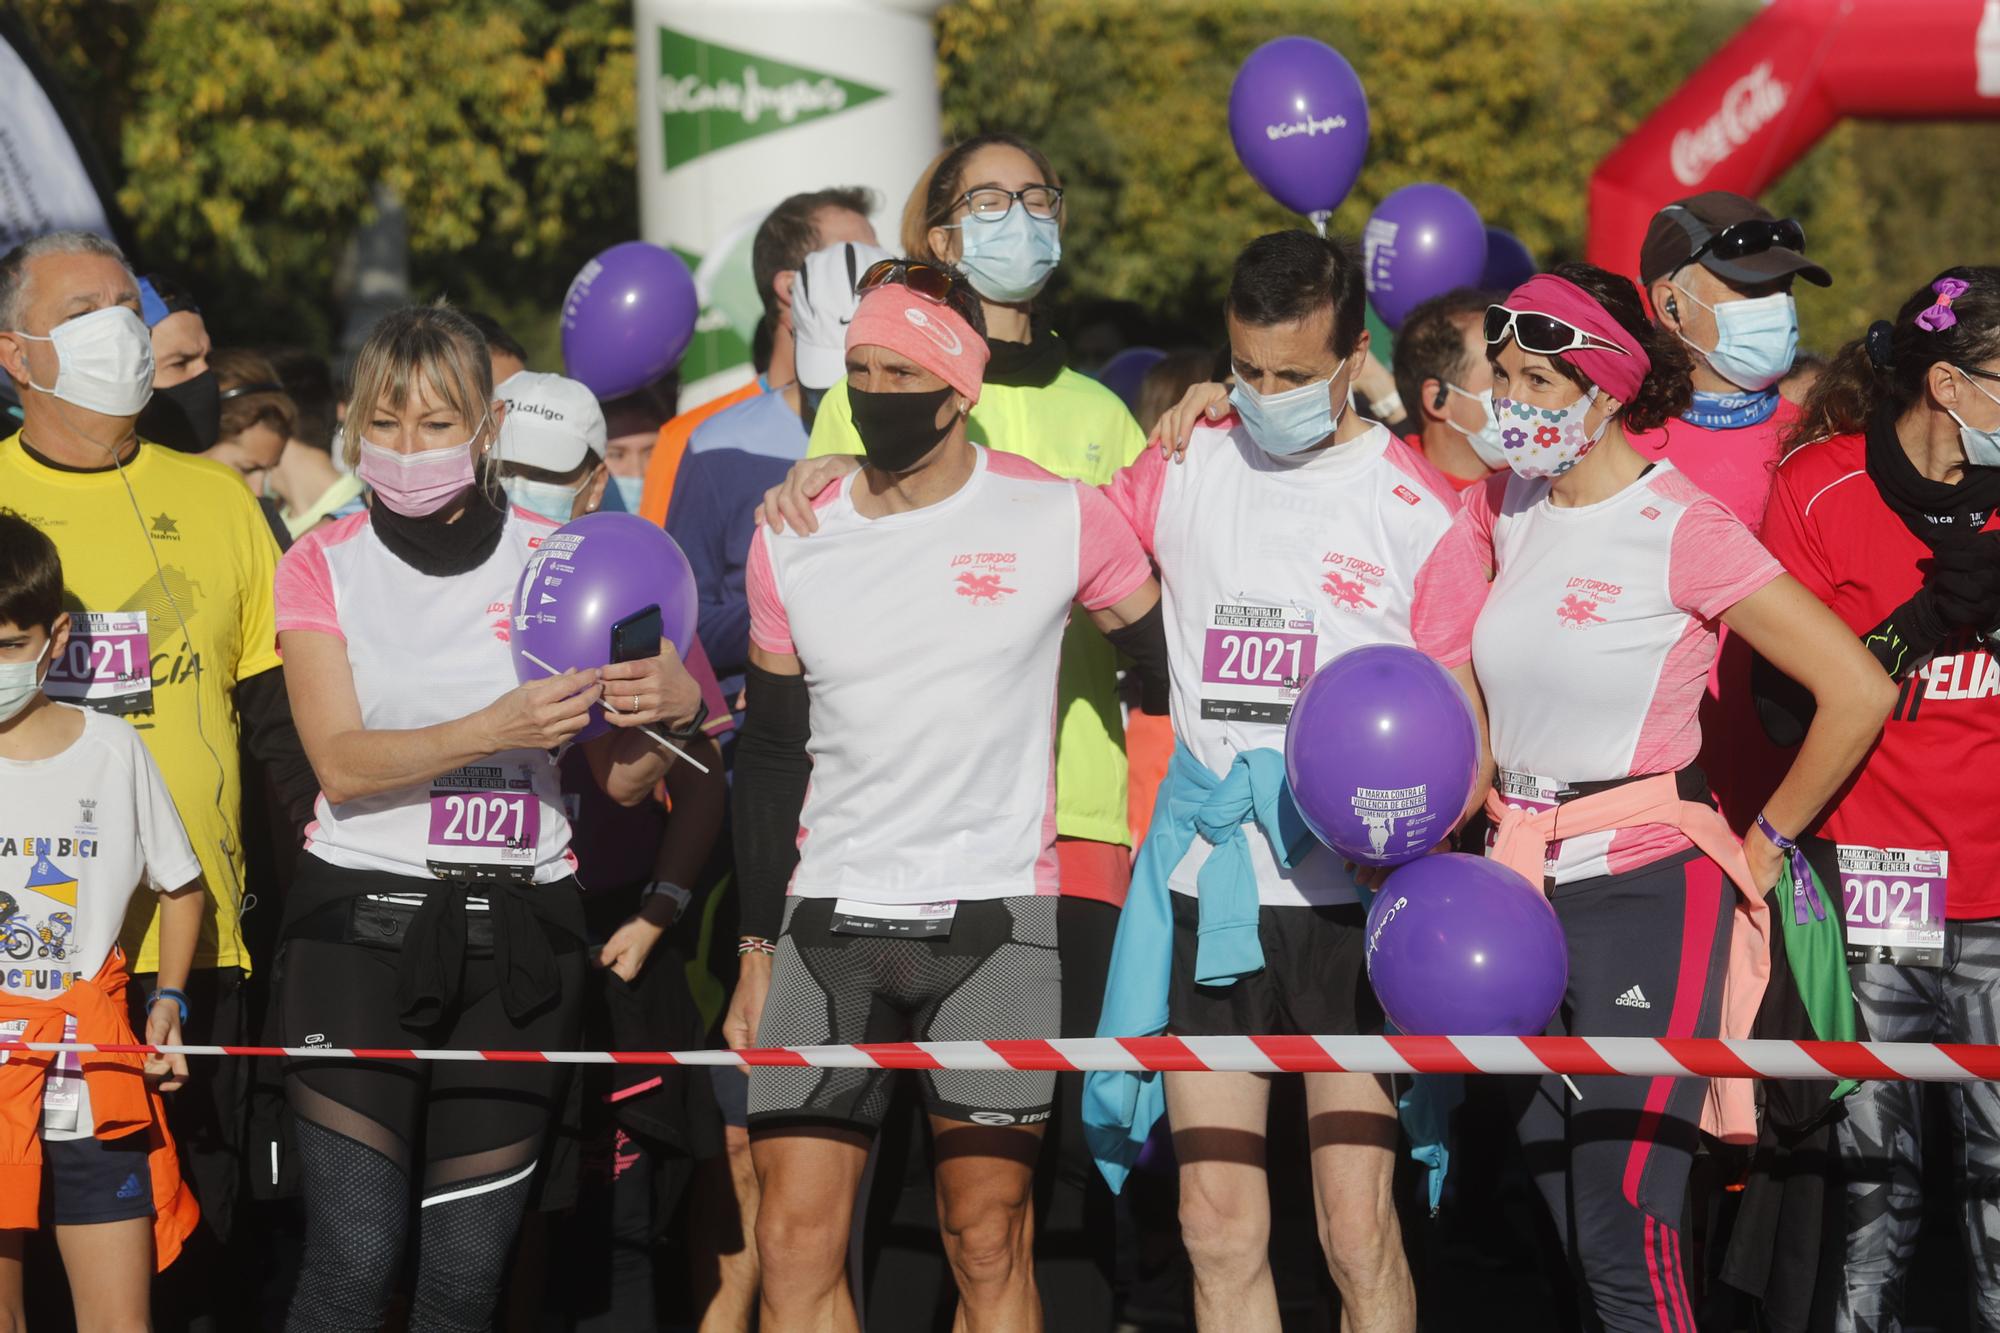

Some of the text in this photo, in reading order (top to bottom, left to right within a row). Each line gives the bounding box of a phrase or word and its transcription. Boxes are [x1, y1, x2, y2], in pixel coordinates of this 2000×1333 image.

[1670, 59, 1790, 186] Coca-Cola
[517, 401, 564, 421] LaLiga
[951, 554, 972, 567] LOS
[975, 552, 1017, 564] TORDOS
[1322, 552, 1386, 577] LOS TORDOS
[1566, 577, 1623, 595] LOS TORDOS
[487, 603, 506, 614] LOS
[1218, 635, 1302, 683] 2021
[1365, 788, 1389, 799] MARXA
[1390, 787, 1416, 799] CONTRA
[1418, 785, 1426, 796] LA
[1353, 798, 1389, 809] VIOLENCIA
[1390, 800, 1399, 809] DE
[1356, 806, 1426, 819] DIUMENGE 28/11/2021
[443, 795, 525, 843] 2021
[23, 837, 51, 857] EN
[57, 838, 98, 858] BICI
[1842, 849, 1865, 860] MARXA
[1894, 852, 1904, 861] LA
[1871, 861, 1881, 871] DE
[1794, 878, 1804, 897] 016
[1844, 878, 1930, 926] 2021
[1615, 996, 1651, 1009] adidas
